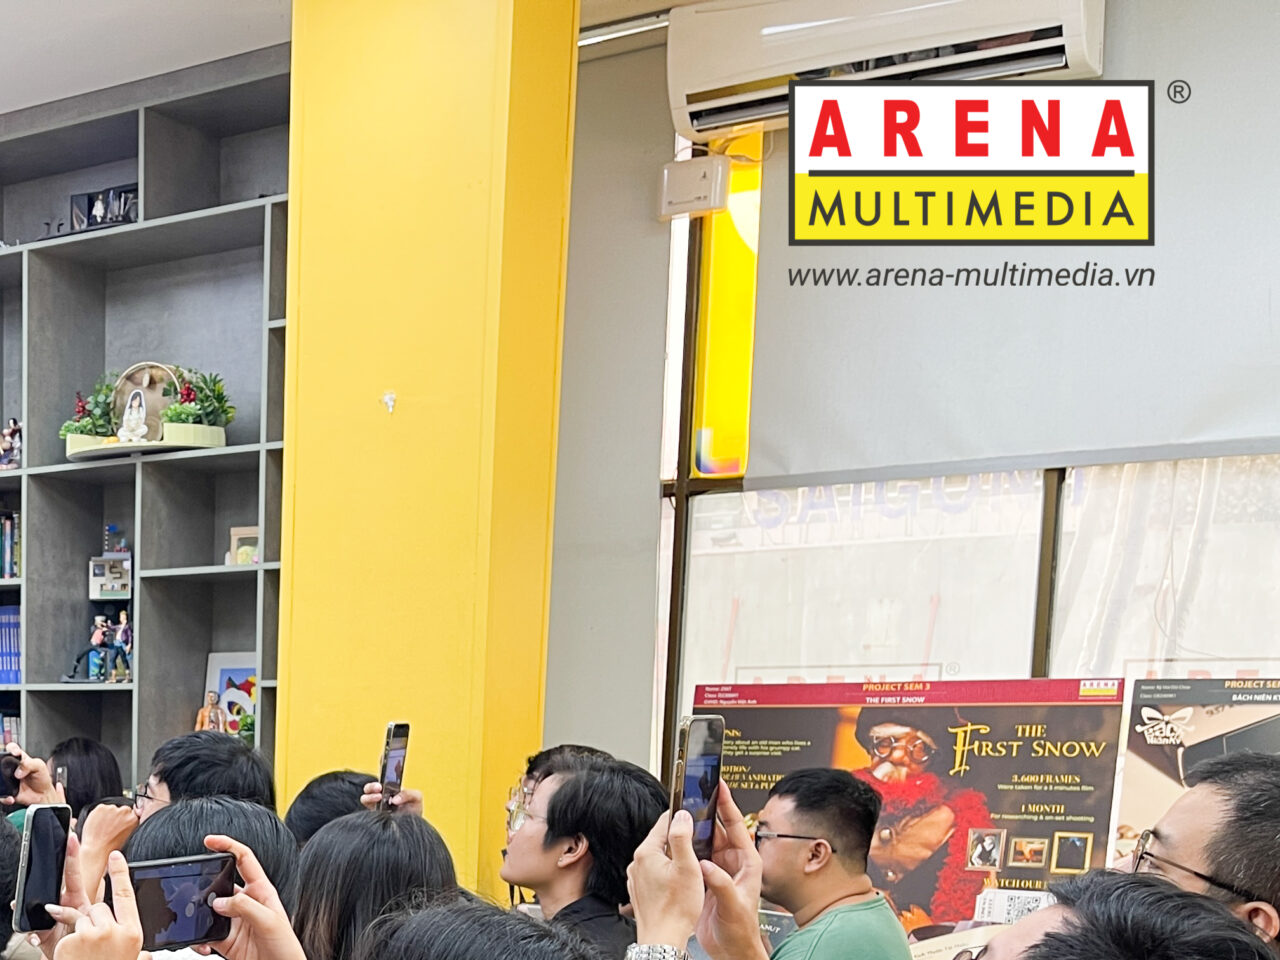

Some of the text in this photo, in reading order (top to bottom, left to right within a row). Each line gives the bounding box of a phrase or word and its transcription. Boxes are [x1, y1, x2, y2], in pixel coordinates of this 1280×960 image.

[862, 683, 901, 691] PROJECT
[903, 683, 923, 691] SEM
[1224, 680, 1265, 688] PROJECT
[866, 696, 879, 704] THE
[880, 696, 900, 704] FIRST
[1015, 724, 1047, 738] THE
[947, 721, 1107, 778] FIRST SNOW
[1040, 774, 1081, 784] FRAMES
[1028, 804, 1065, 813] MONTH
